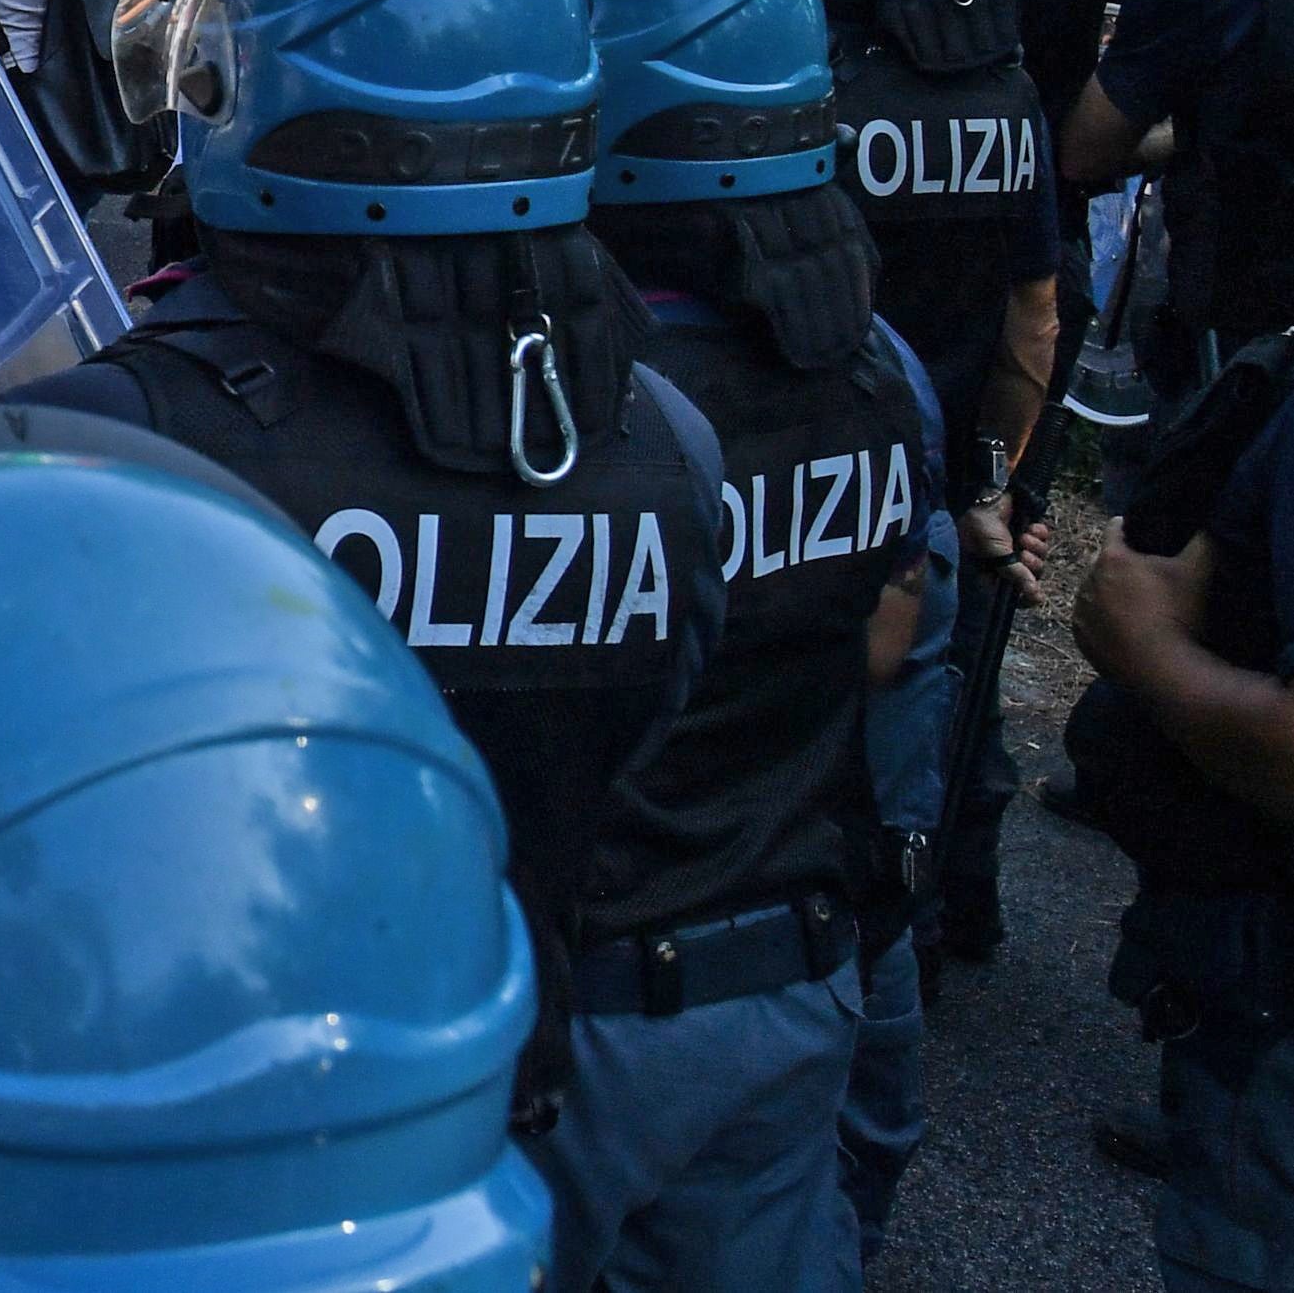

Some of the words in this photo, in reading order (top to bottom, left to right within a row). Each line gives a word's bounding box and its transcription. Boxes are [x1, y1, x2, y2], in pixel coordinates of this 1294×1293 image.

[856, 117, 1036, 198] OLIZIA
[314, 508, 669, 648] OLIZIA
[721, 442, 914, 583] OLIZIA
